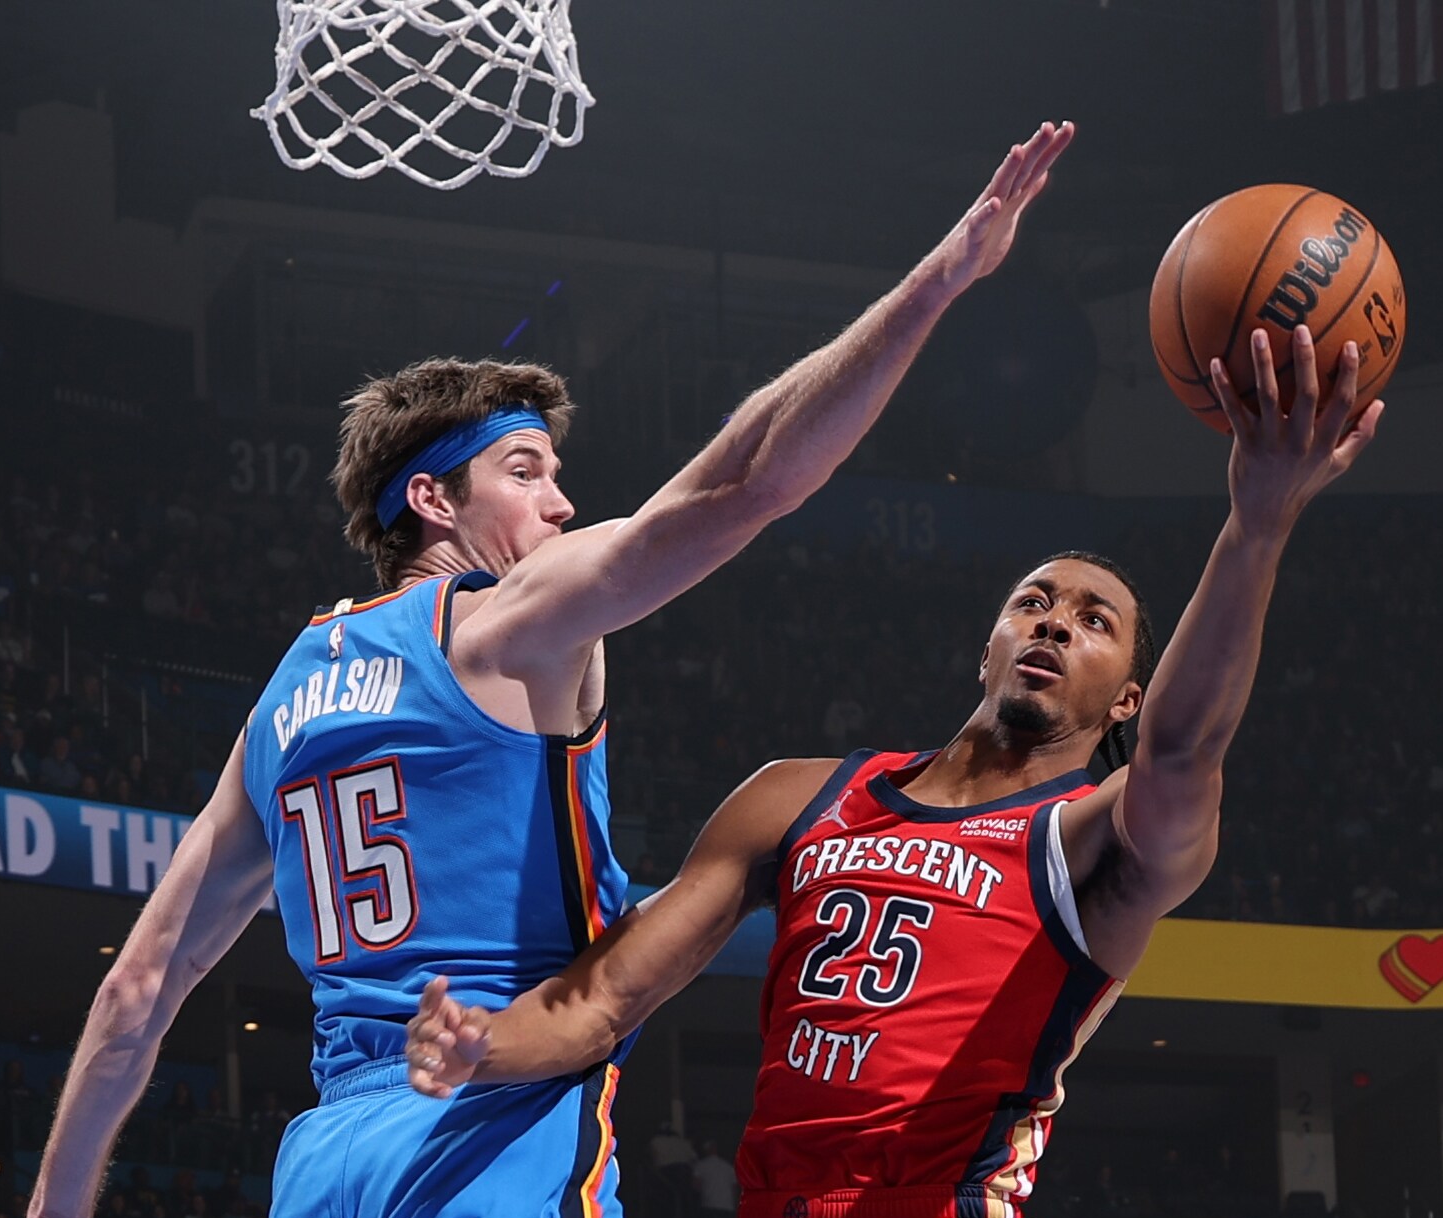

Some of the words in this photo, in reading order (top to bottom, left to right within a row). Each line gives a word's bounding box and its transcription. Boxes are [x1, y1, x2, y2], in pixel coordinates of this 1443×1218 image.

[1258, 206, 1368, 331] Wilson
[229, 439, 310, 498] 312
[273, 656, 403, 753] CARLSON
[80, 804, 197, 894] TH
[277, 755, 419, 966] 15
[959, 818, 1028, 831] NEWAGE
[959, 829, 1016, 840] PRODUCTS
[792, 836, 1003, 909] CRESCENT
[797, 887, 935, 1008] 25
[787, 1017, 880, 1082] CITY
